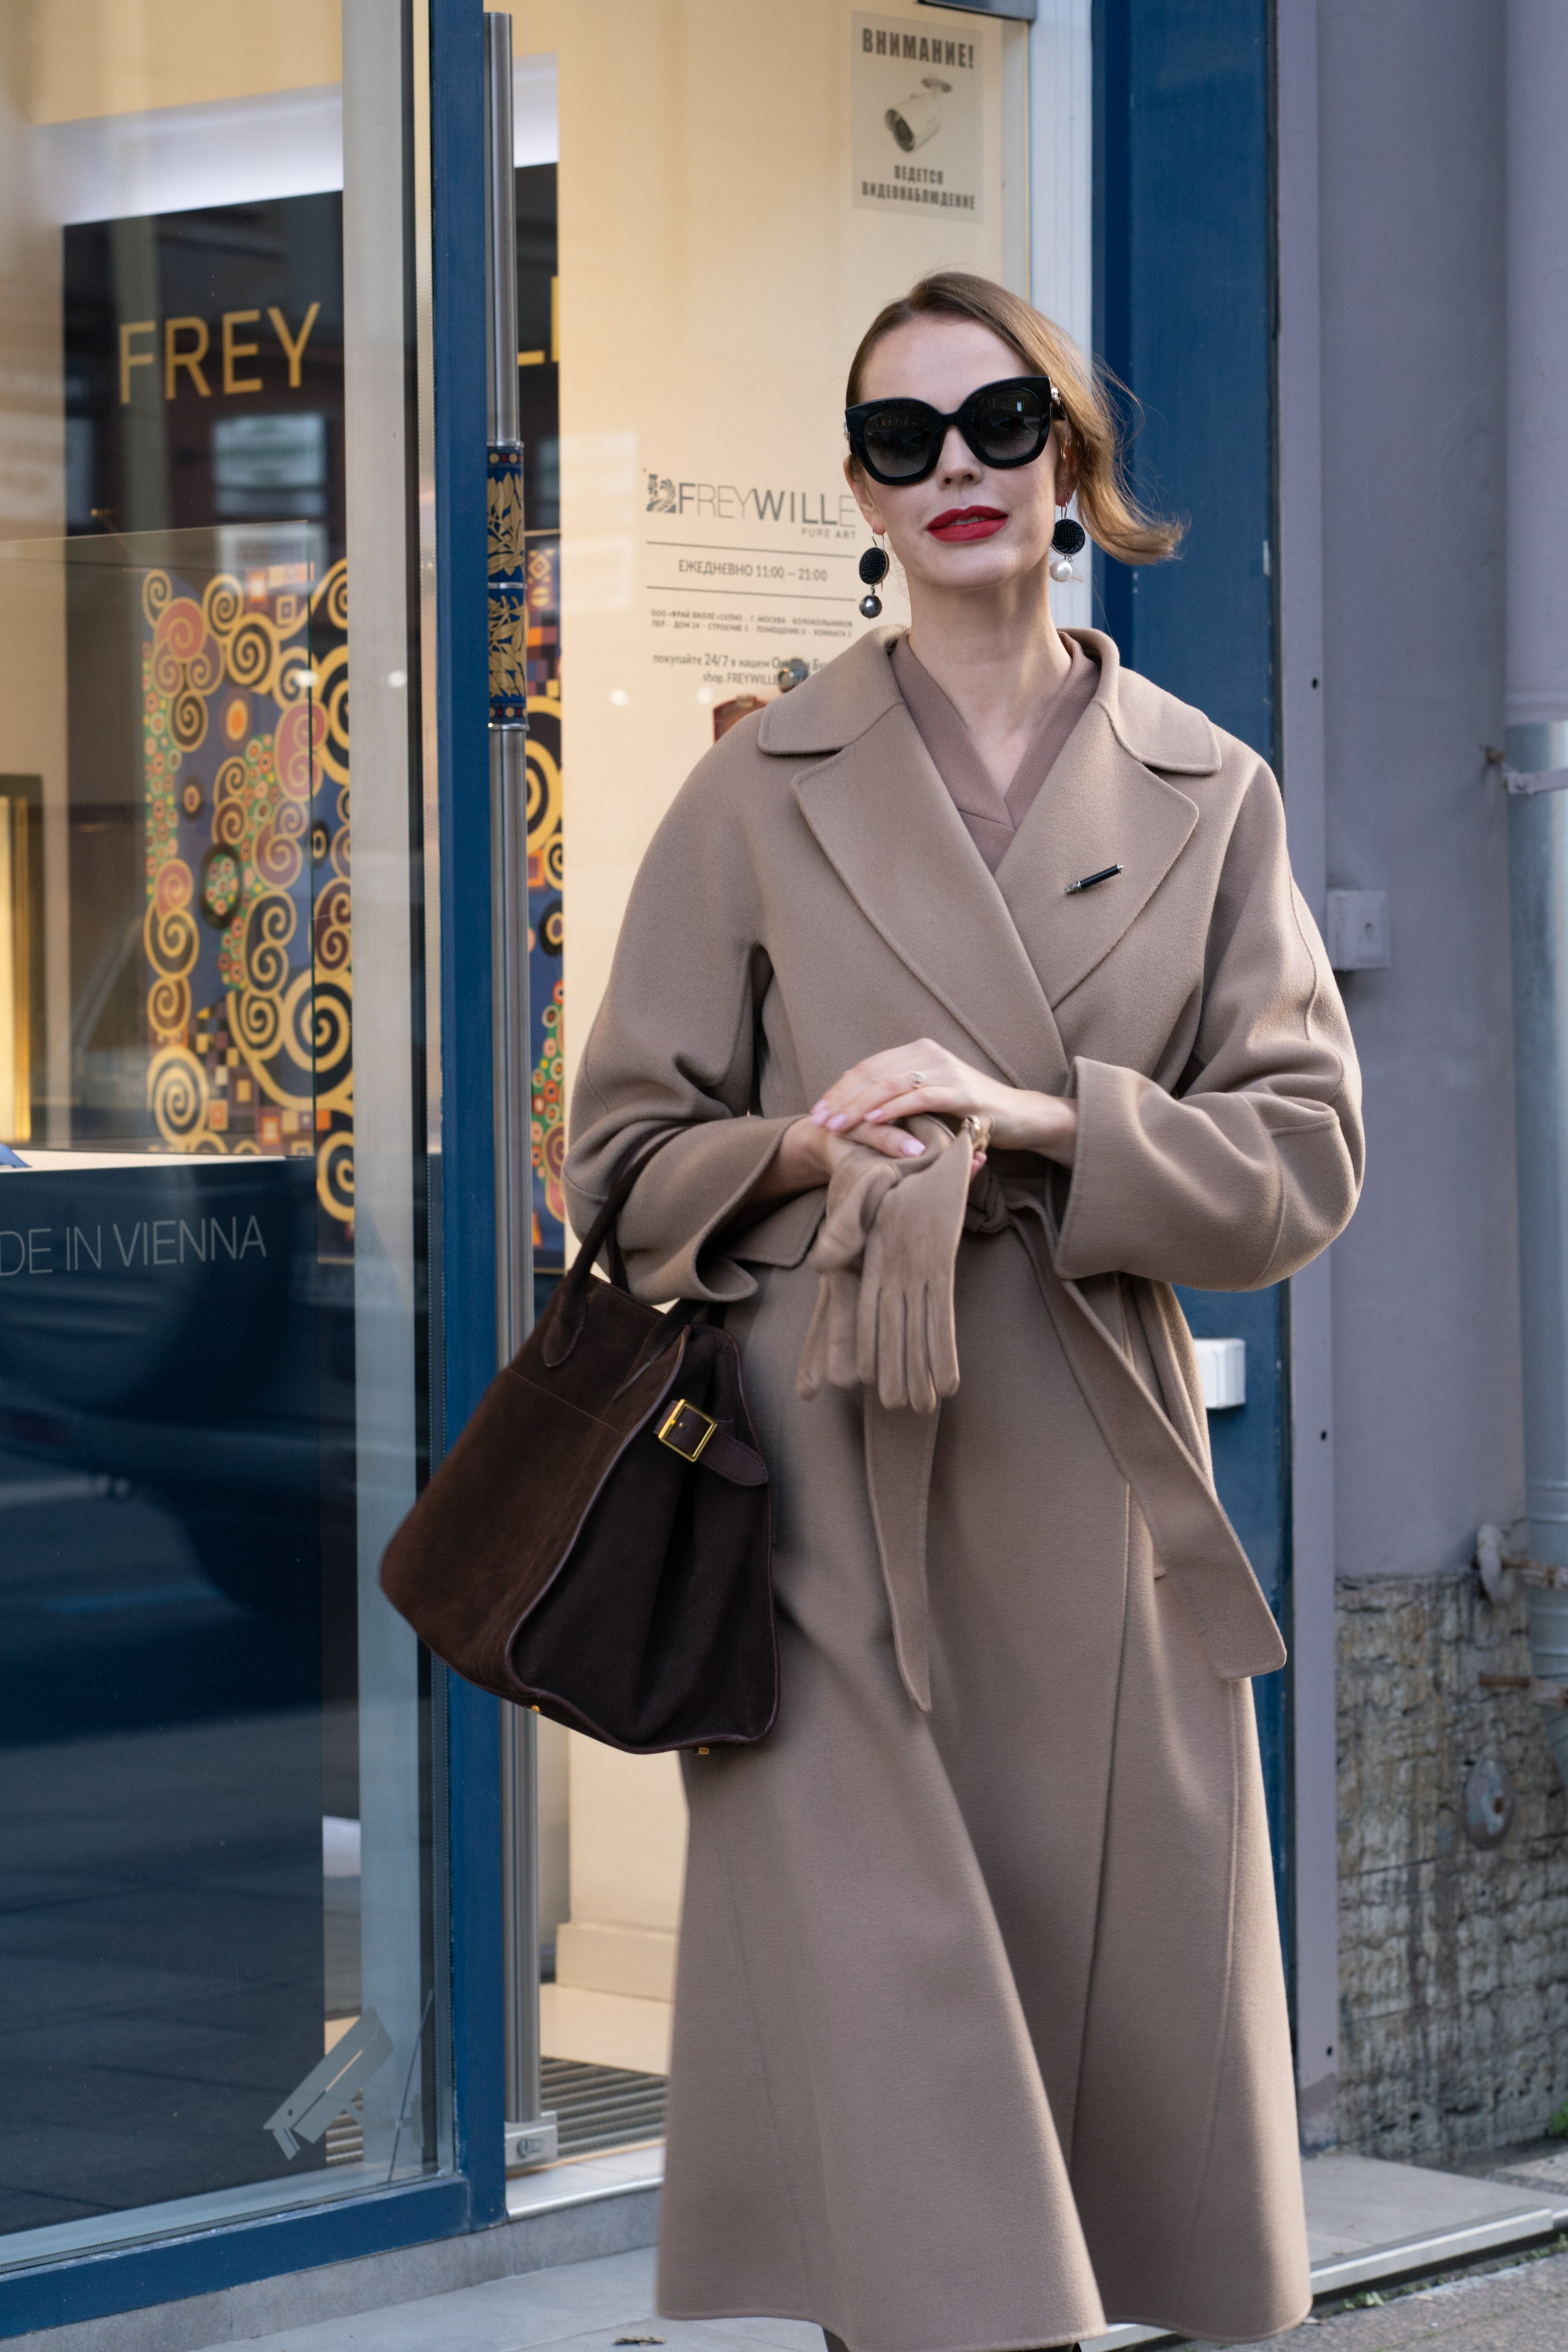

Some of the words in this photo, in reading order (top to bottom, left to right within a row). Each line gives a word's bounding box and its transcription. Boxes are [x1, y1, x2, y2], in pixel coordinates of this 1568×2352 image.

[863, 28, 974, 69] ВНИМАНИЕ!
[894, 165, 943, 185] ВЕДЕТСЯ
[862, 181, 975, 209] ВИДЕОНАБЛЮДЕНИЕ
[119, 303, 320, 404] FREY
[679, 483, 856, 528] FREYWILLE
[801, 527, 830, 538] PURE
[835, 530, 856, 540] ART
[679, 559, 753, 576] ЕЖЕДНЕВНО
[756, 565, 785, 579] 11:00
[798, 568, 827, 581] 21:00
[650, 609, 666, 617] ООО
[653, 654, 702, 666] покупайте
[704, 653, 728, 668] 24/7
[739, 659, 770, 668] нашем
[66, 1225, 102, 1272] IN
[113, 1215, 267, 1267] VIENNA
